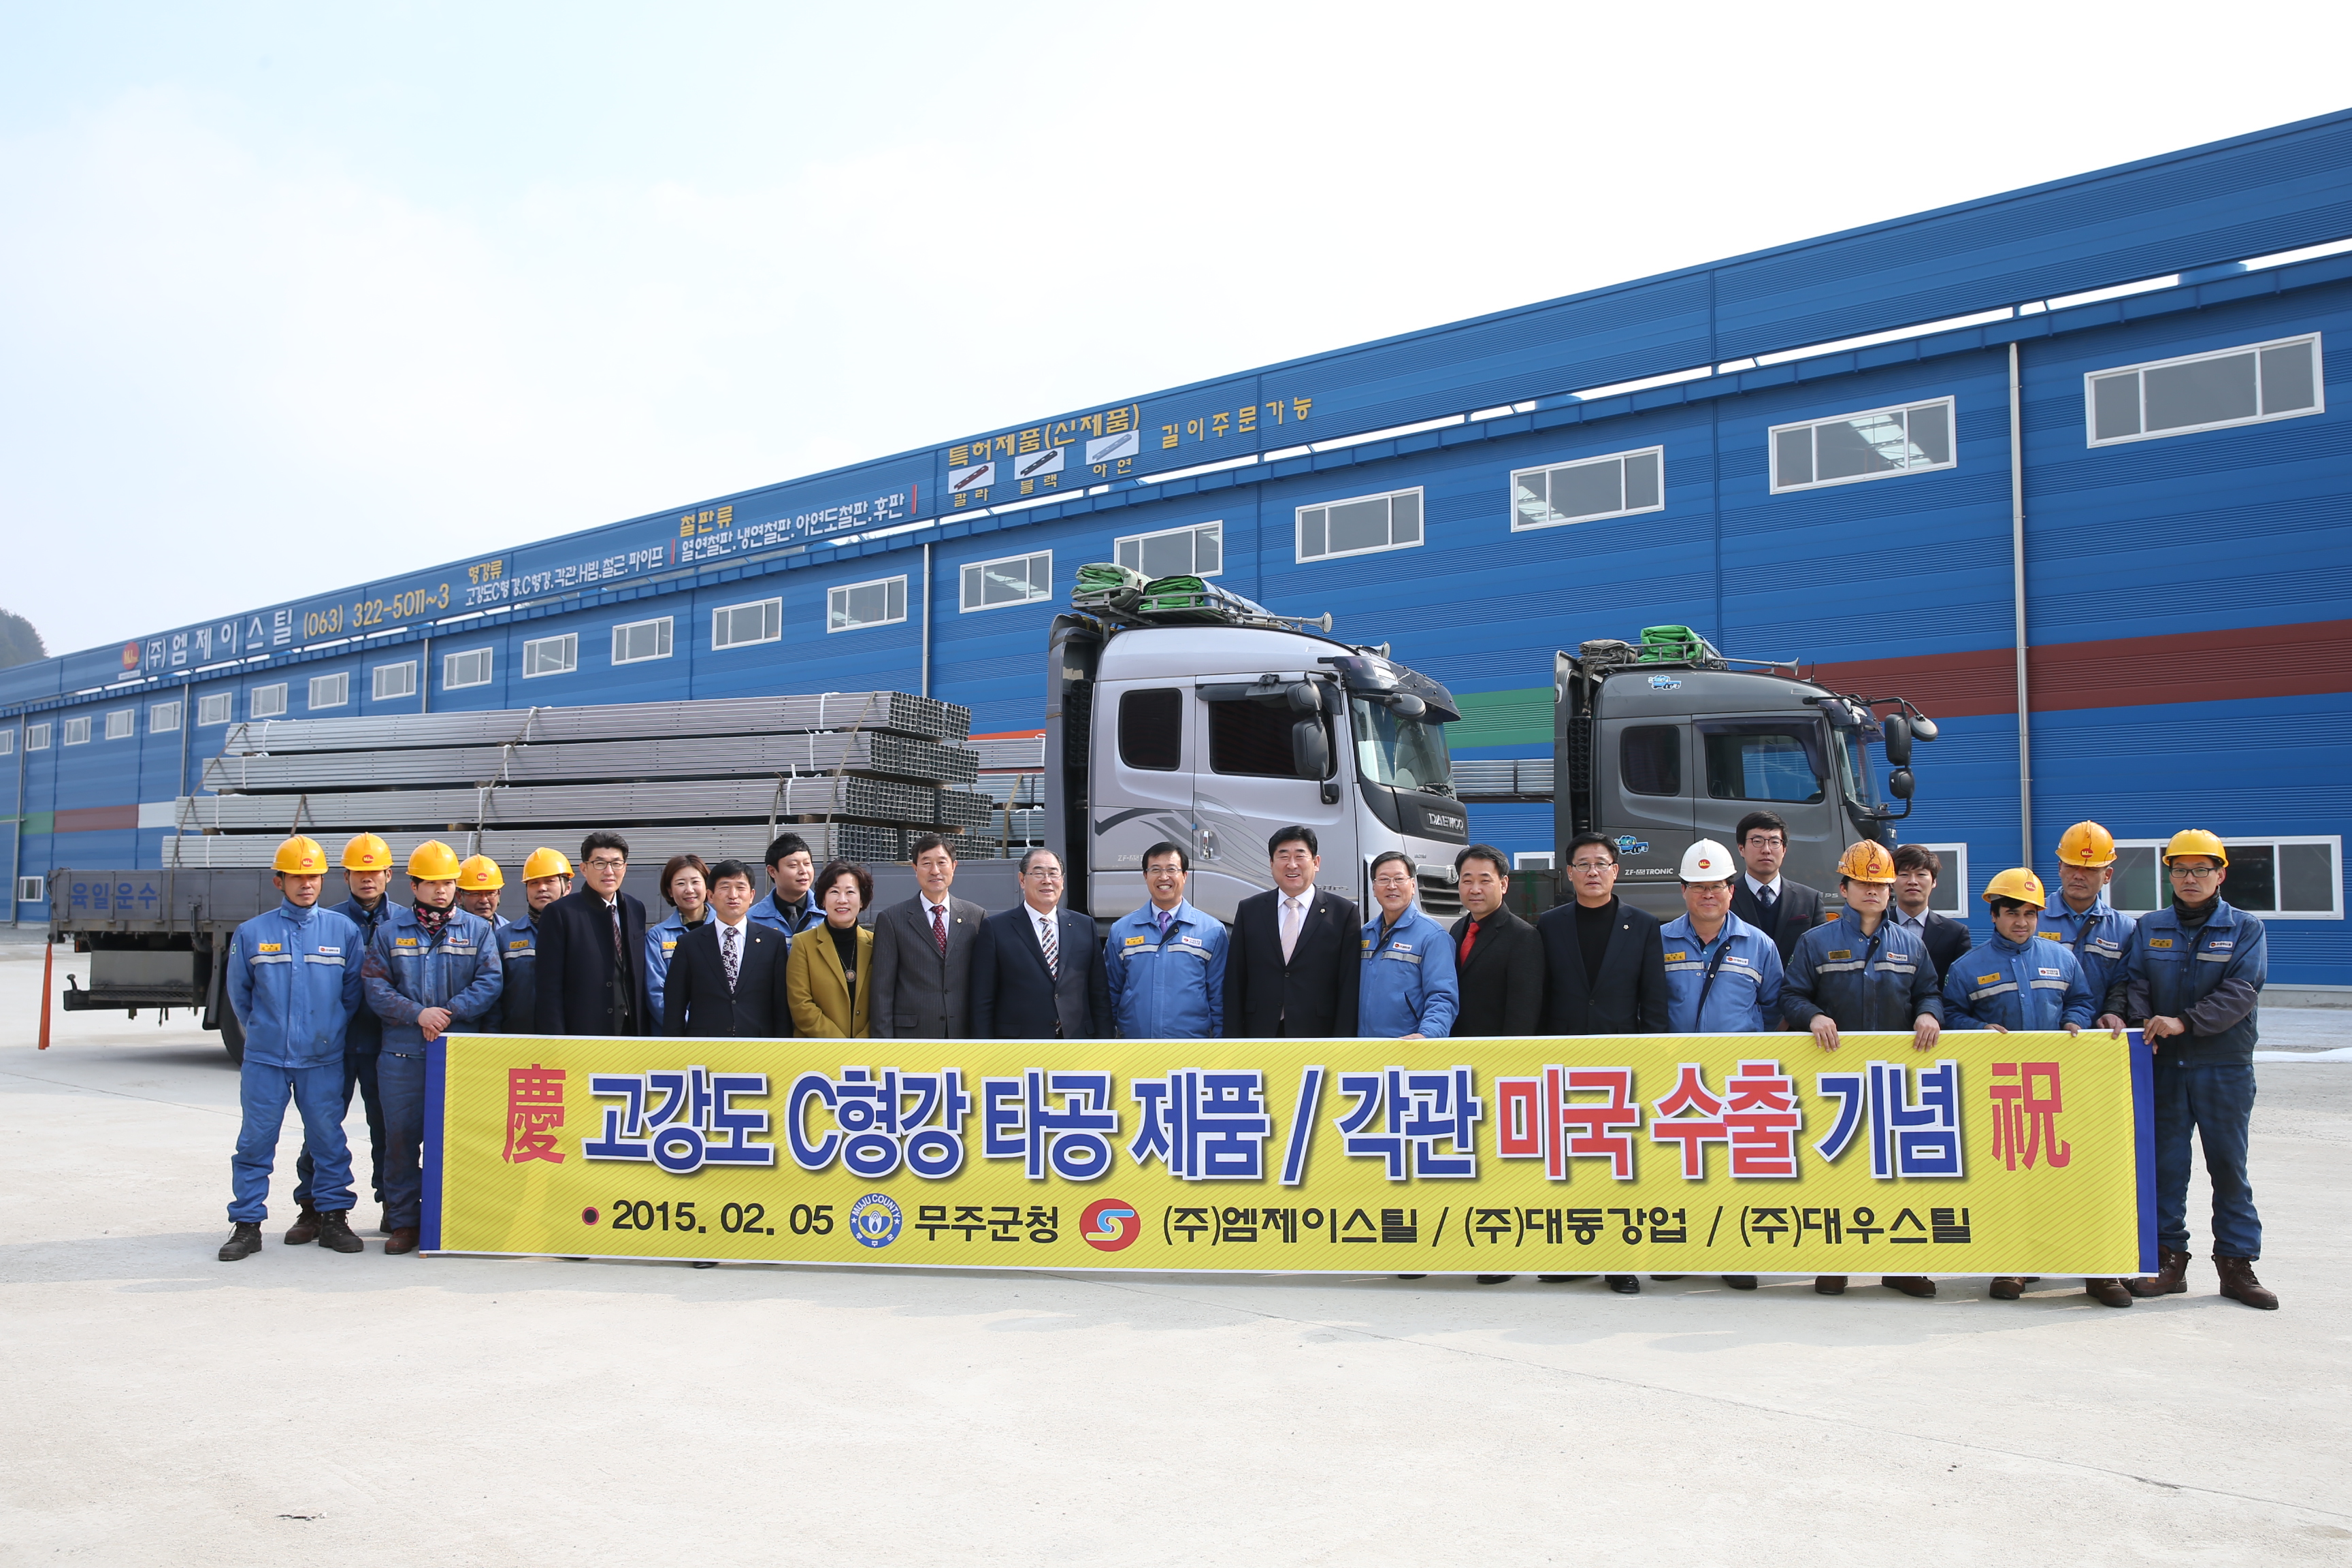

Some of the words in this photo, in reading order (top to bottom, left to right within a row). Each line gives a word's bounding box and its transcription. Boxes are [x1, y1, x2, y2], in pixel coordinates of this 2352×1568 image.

[680, 505, 733, 538] 철판류
[468, 559, 503, 585] 형강류
[304, 604, 344, 640] (063)
[353, 583, 450, 627] 322-5011~3
[1427, 812, 1464, 831] DAEWOO
[503, 1064, 566, 1164] 慶
[585, 1067, 773, 1171] 고강도
[787, 1067, 968, 1176] C형강
[984, 1070, 1115, 1178] 타공
[1131, 1071, 1267, 1178] 제품
[1337, 1067, 1480, 1179] 각관
[1498, 1066, 1637, 1178] 미국
[1652, 1062, 1799, 1177] 수출
[1817, 1062, 1961, 1177] 기념
[1990, 1062, 2070, 1171] 祝
[612, 1200, 706, 1234] 2015.
[721, 1203, 774, 1236] 02.
[789, 1204, 834, 1235] 05
[851, 1196, 872, 1217] MUJU
[872, 1194, 901, 1218] COUNTY
[914, 1205, 1059, 1243] 무주군청
[1164, 1205, 1418, 1246] (주)엠제이스틸
[1465, 1207, 1687, 1247] (주)대동강업
[1740, 1205, 1972, 1247] (주)대우스틸
